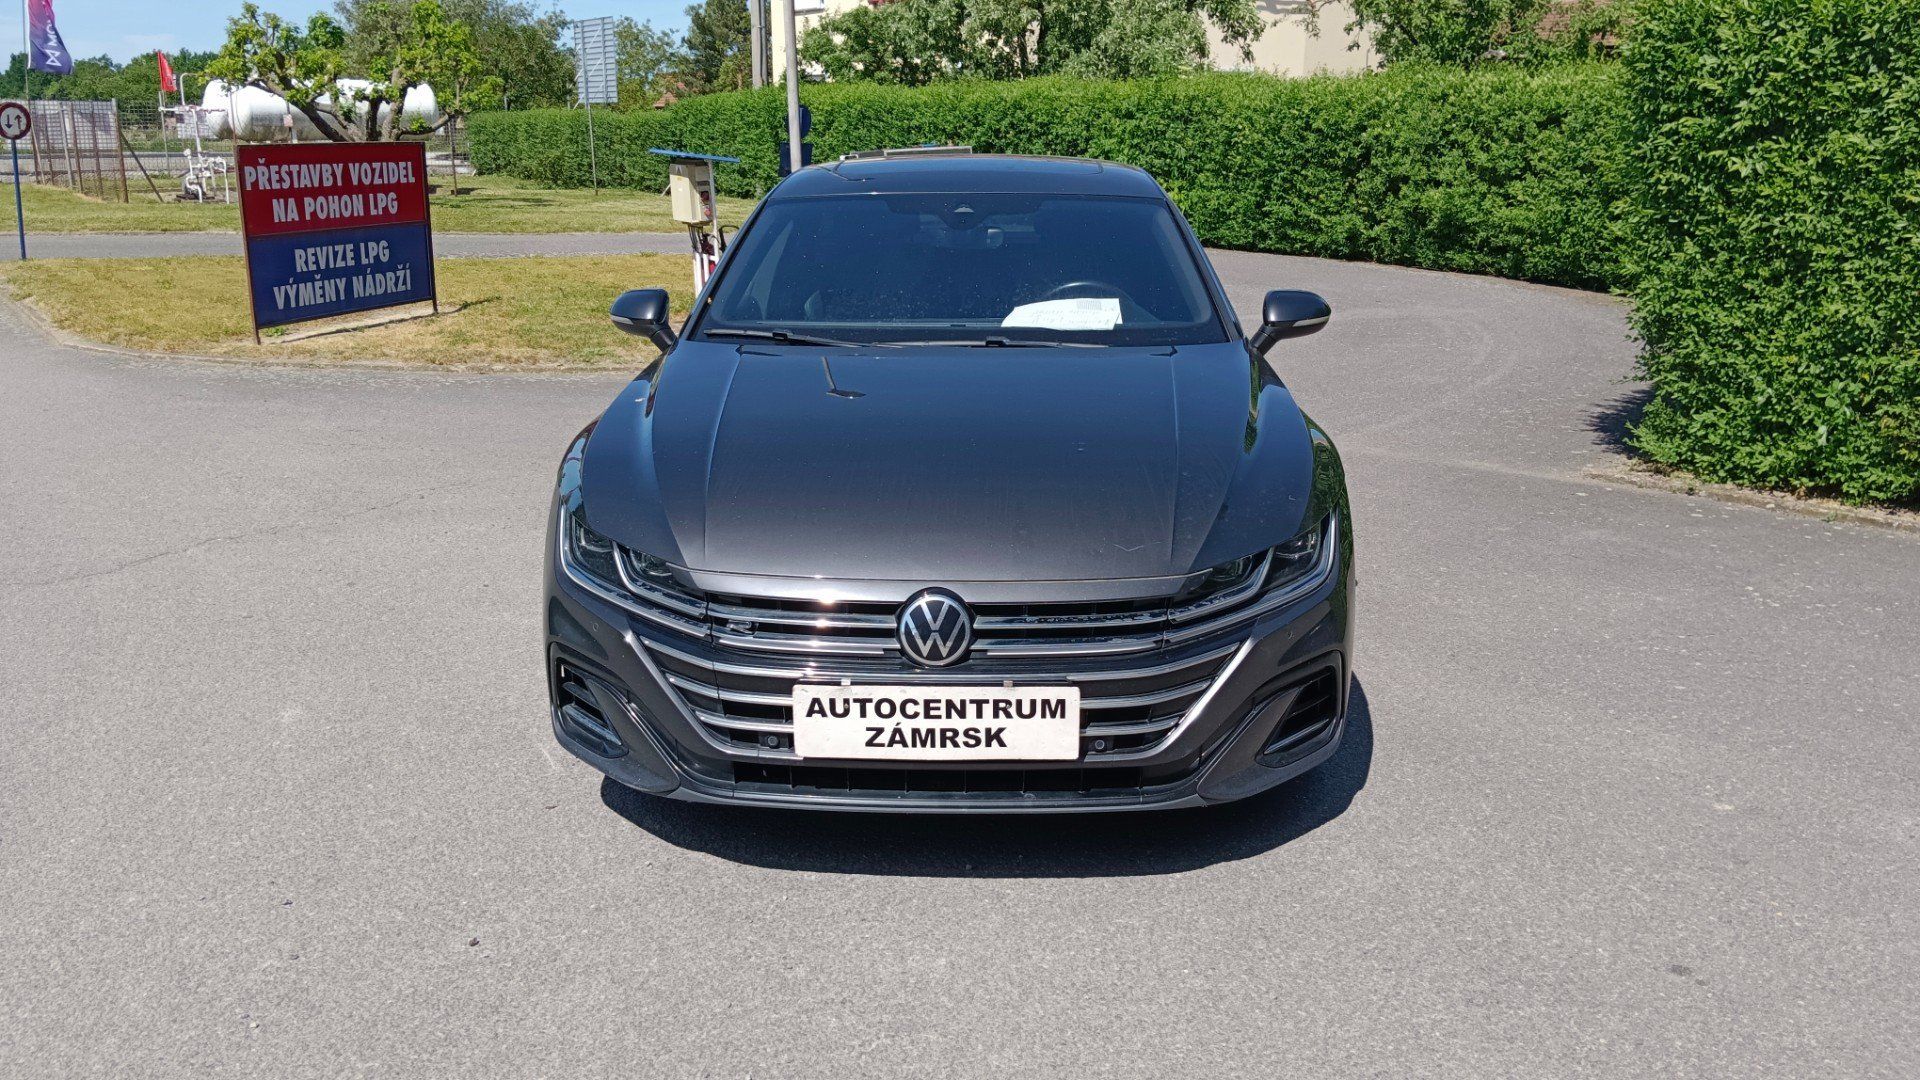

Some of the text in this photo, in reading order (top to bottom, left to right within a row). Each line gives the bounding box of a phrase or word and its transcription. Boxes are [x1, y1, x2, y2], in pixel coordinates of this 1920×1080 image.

[244, 158, 416, 190] PŘESTAVBY VOZIDEL
[272, 192, 398, 222] NA POHON LPG
[294, 240, 390, 272] REVIZE LPG
[273, 263, 411, 310] VÝMĚNY NÁDRŽÍ
[806, 698, 1066, 719] AUTOCENTRUM
[865, 722, 1007, 748] ZÁMRSK
